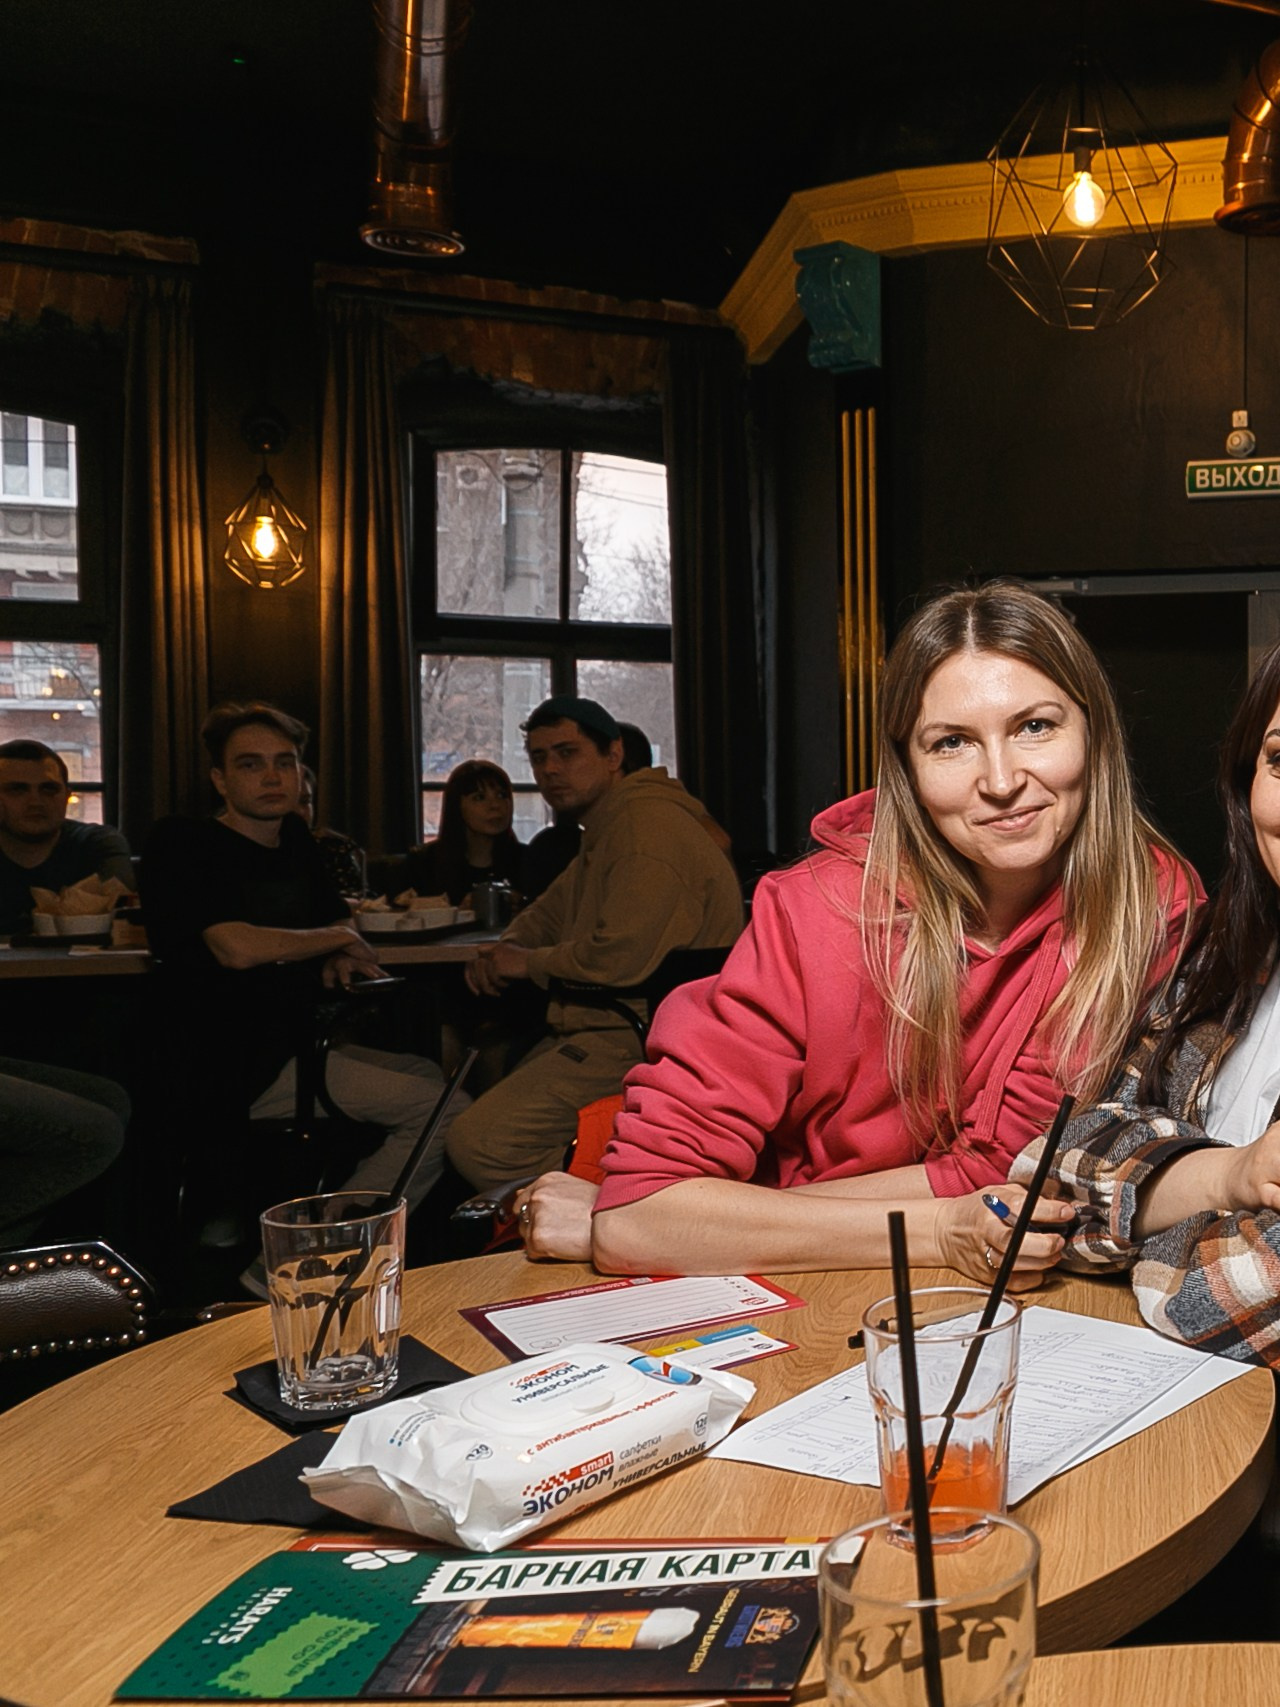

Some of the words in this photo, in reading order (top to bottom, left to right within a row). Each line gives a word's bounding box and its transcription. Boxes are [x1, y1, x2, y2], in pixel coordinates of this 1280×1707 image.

[512, 1363, 610, 1404] УНИВЕРСАЛЬНЫЕ
[515, 1364, 580, 1391] ЭКОНОМ
[580, 1453, 613, 1476] smart
[618, 1448, 659, 1472] влажные
[619, 1435, 662, 1460] салфетки
[612, 1441, 707, 1490] УНИВЕРСАЛЬНЫЕ
[522, 1465, 614, 1517] ЭКОНОМ
[442, 1556, 648, 1594] БАРНАЯ
[657, 1548, 811, 1580] КАРТА
